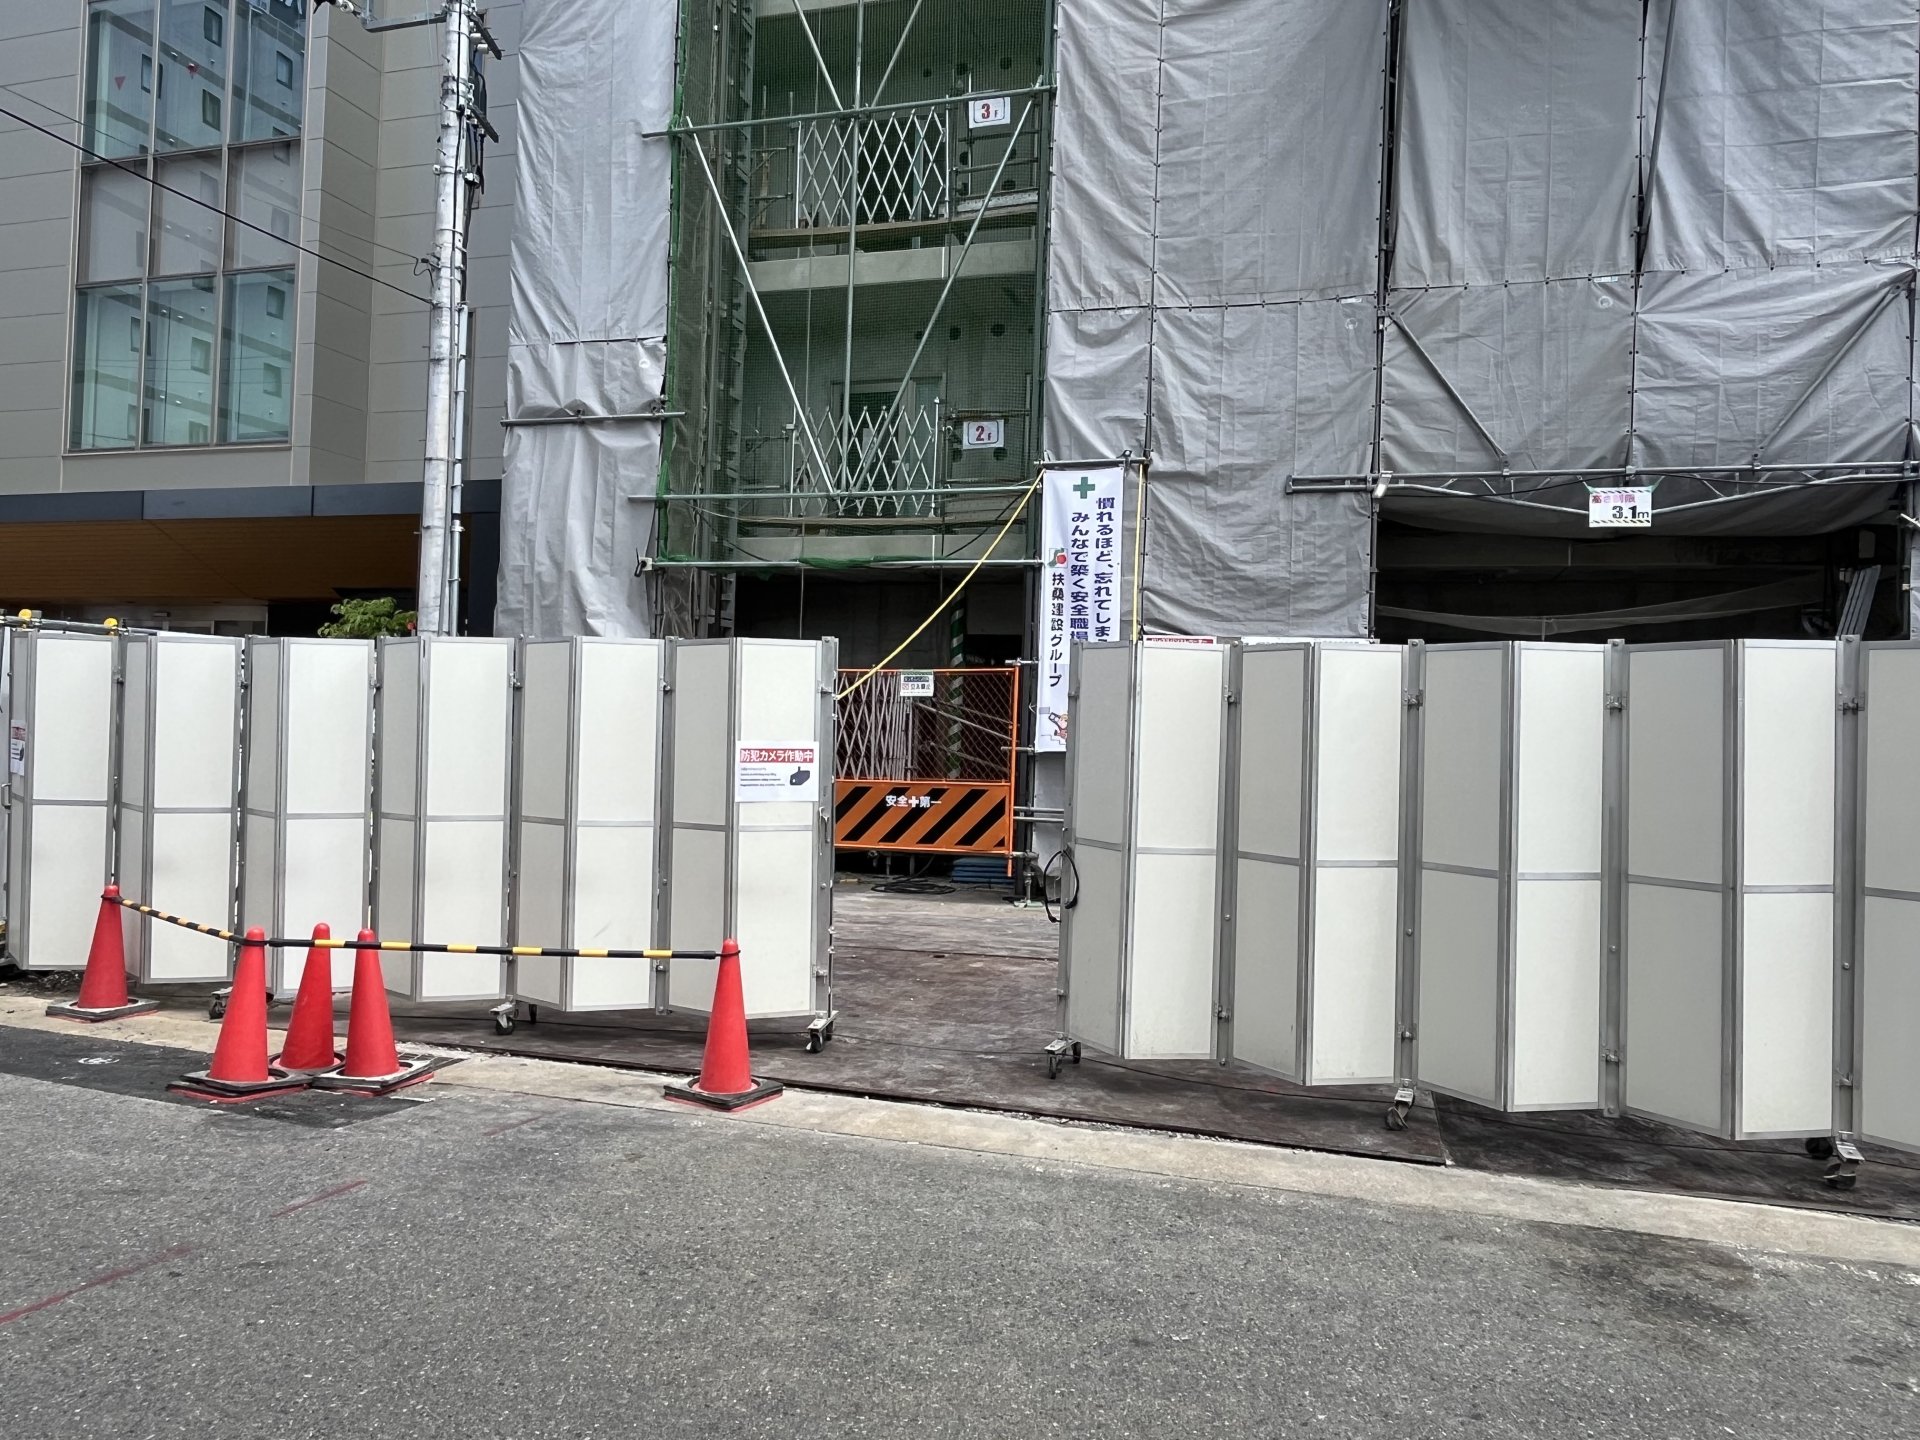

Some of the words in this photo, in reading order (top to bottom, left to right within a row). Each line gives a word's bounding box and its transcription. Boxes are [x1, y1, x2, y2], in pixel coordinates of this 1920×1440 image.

[1612, 505, 1650, 519] 3.1m
[1094, 497, 1115, 642] 慣れるほど、忘れてしま
[1050, 572, 1065, 687] 扶桑建設グループ
[740, 749, 813, 762] 防犯カメラ作動中
